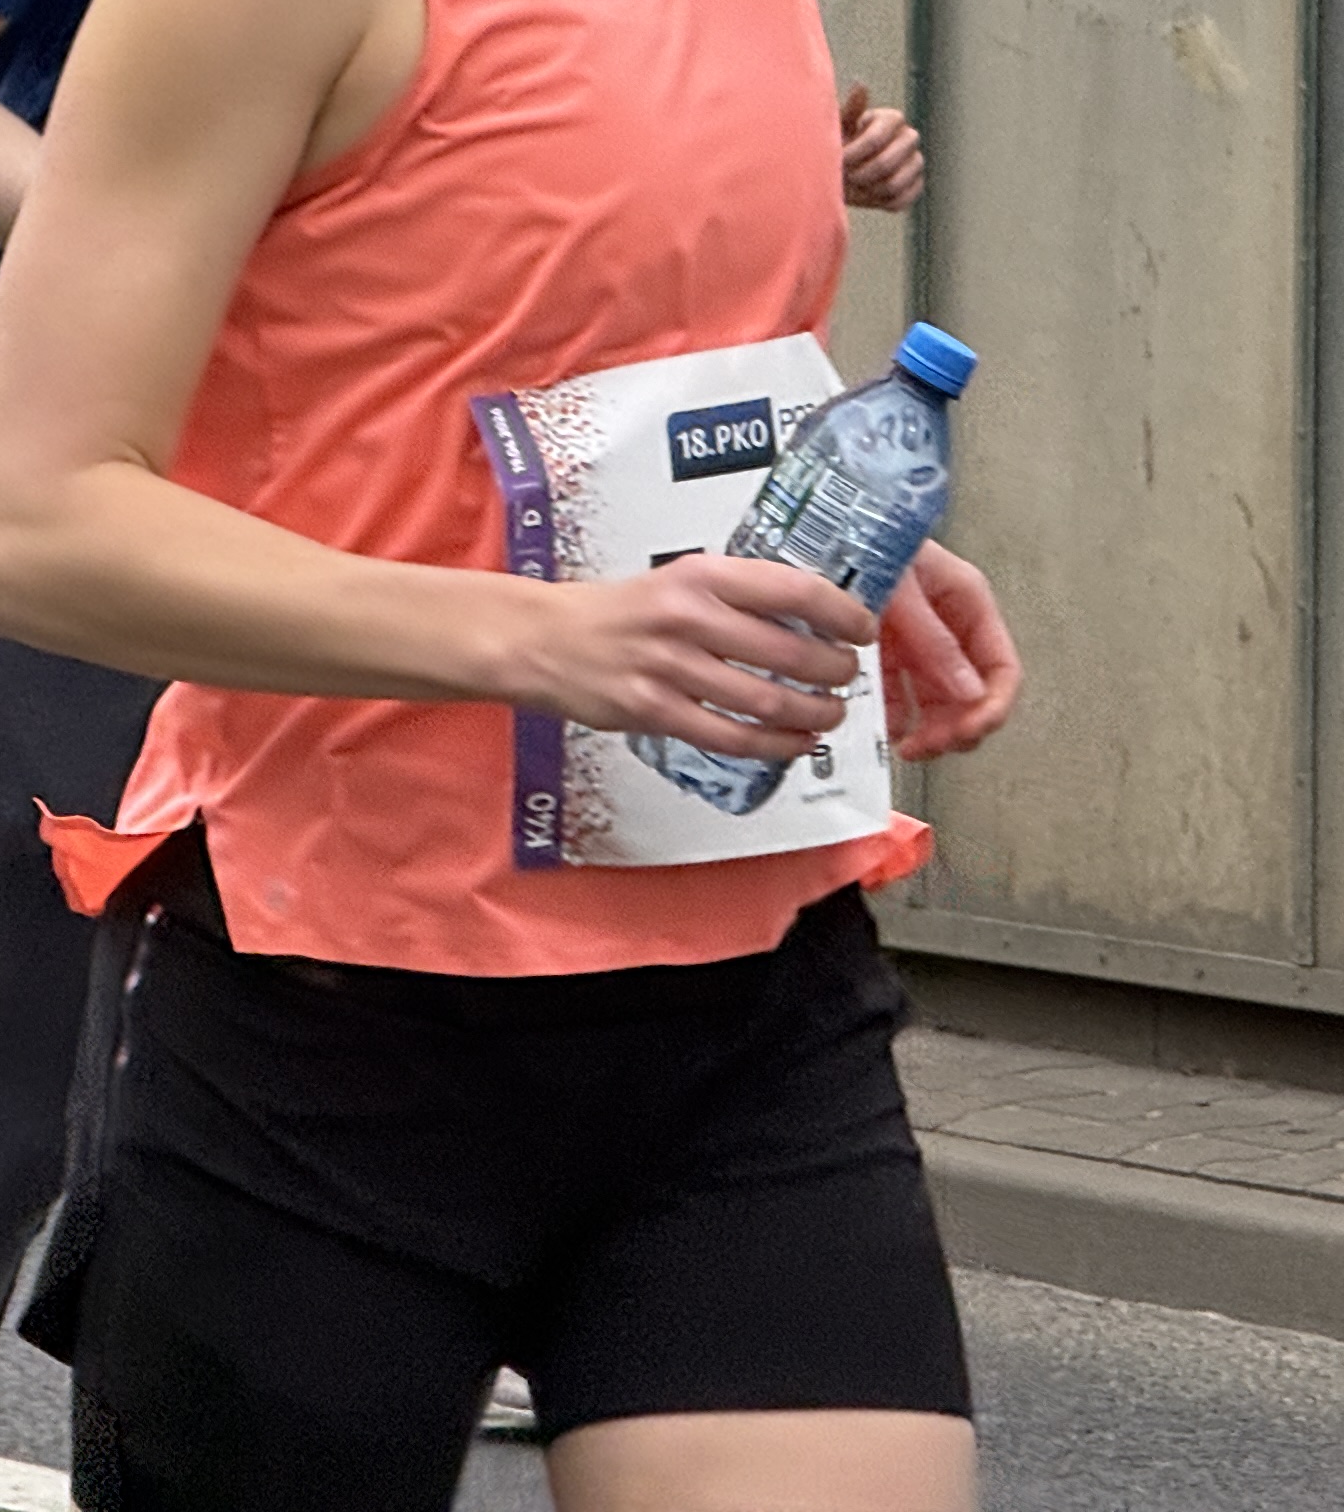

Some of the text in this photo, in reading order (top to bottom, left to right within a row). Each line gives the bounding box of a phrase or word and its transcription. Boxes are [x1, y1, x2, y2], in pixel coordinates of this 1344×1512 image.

[676, 418, 770, 460] 18.PKO
[522, 509, 543, 528] D
[523, 791, 558, 849] K40
